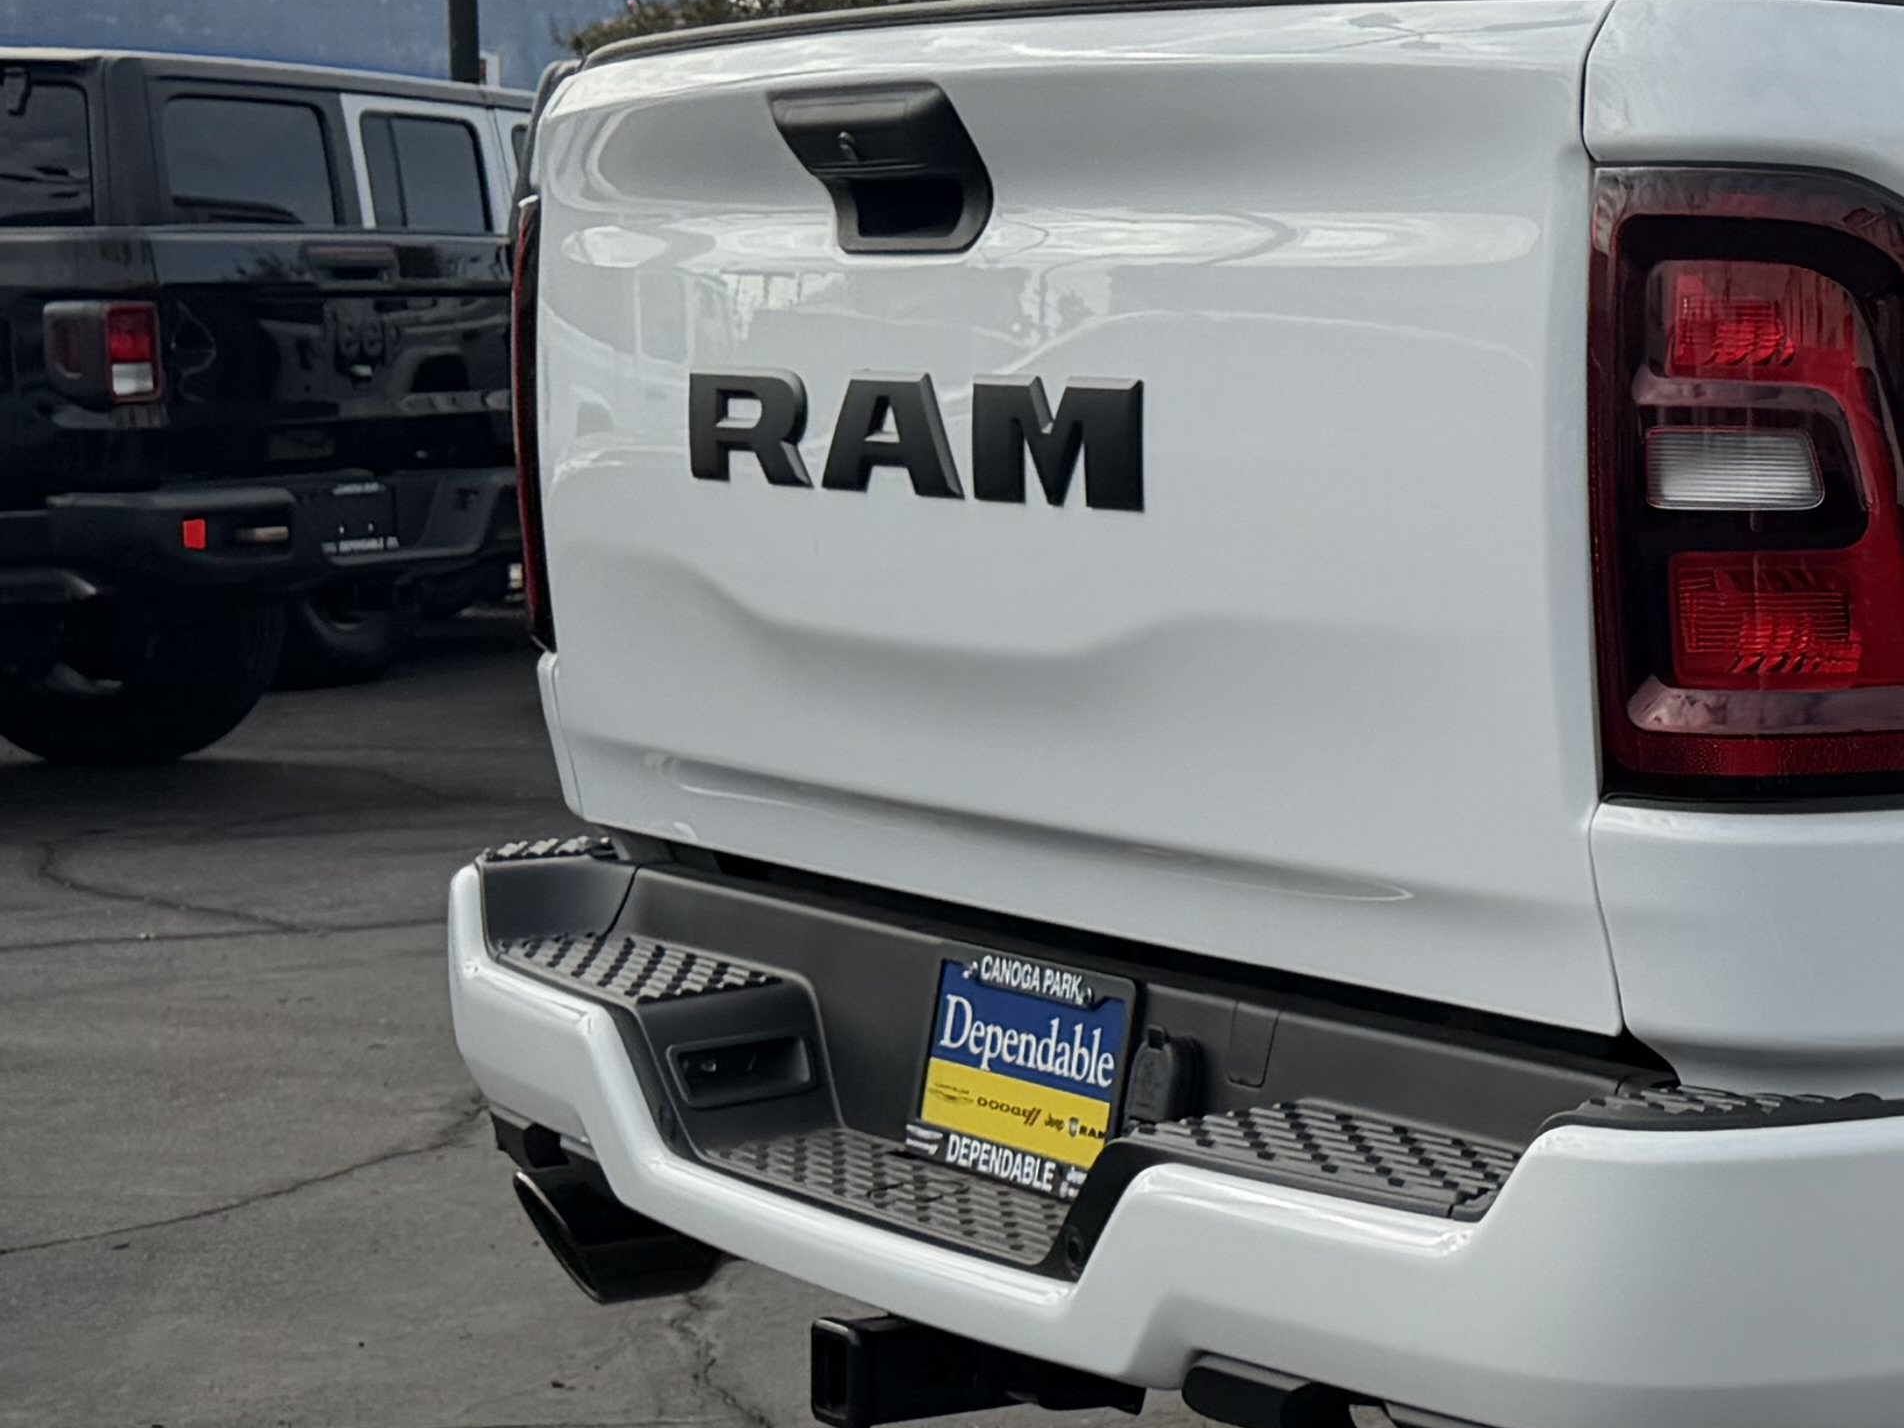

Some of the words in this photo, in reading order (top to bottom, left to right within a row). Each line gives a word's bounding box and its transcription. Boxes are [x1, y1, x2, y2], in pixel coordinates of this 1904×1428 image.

[688, 368, 1144, 512] RAM
[981, 955, 1040, 992] CANOGA
[1043, 969, 1083, 1005] PARK
[940, 994, 1114, 1087] Dependable
[946, 1133, 1056, 1191] DEPENDABLE
